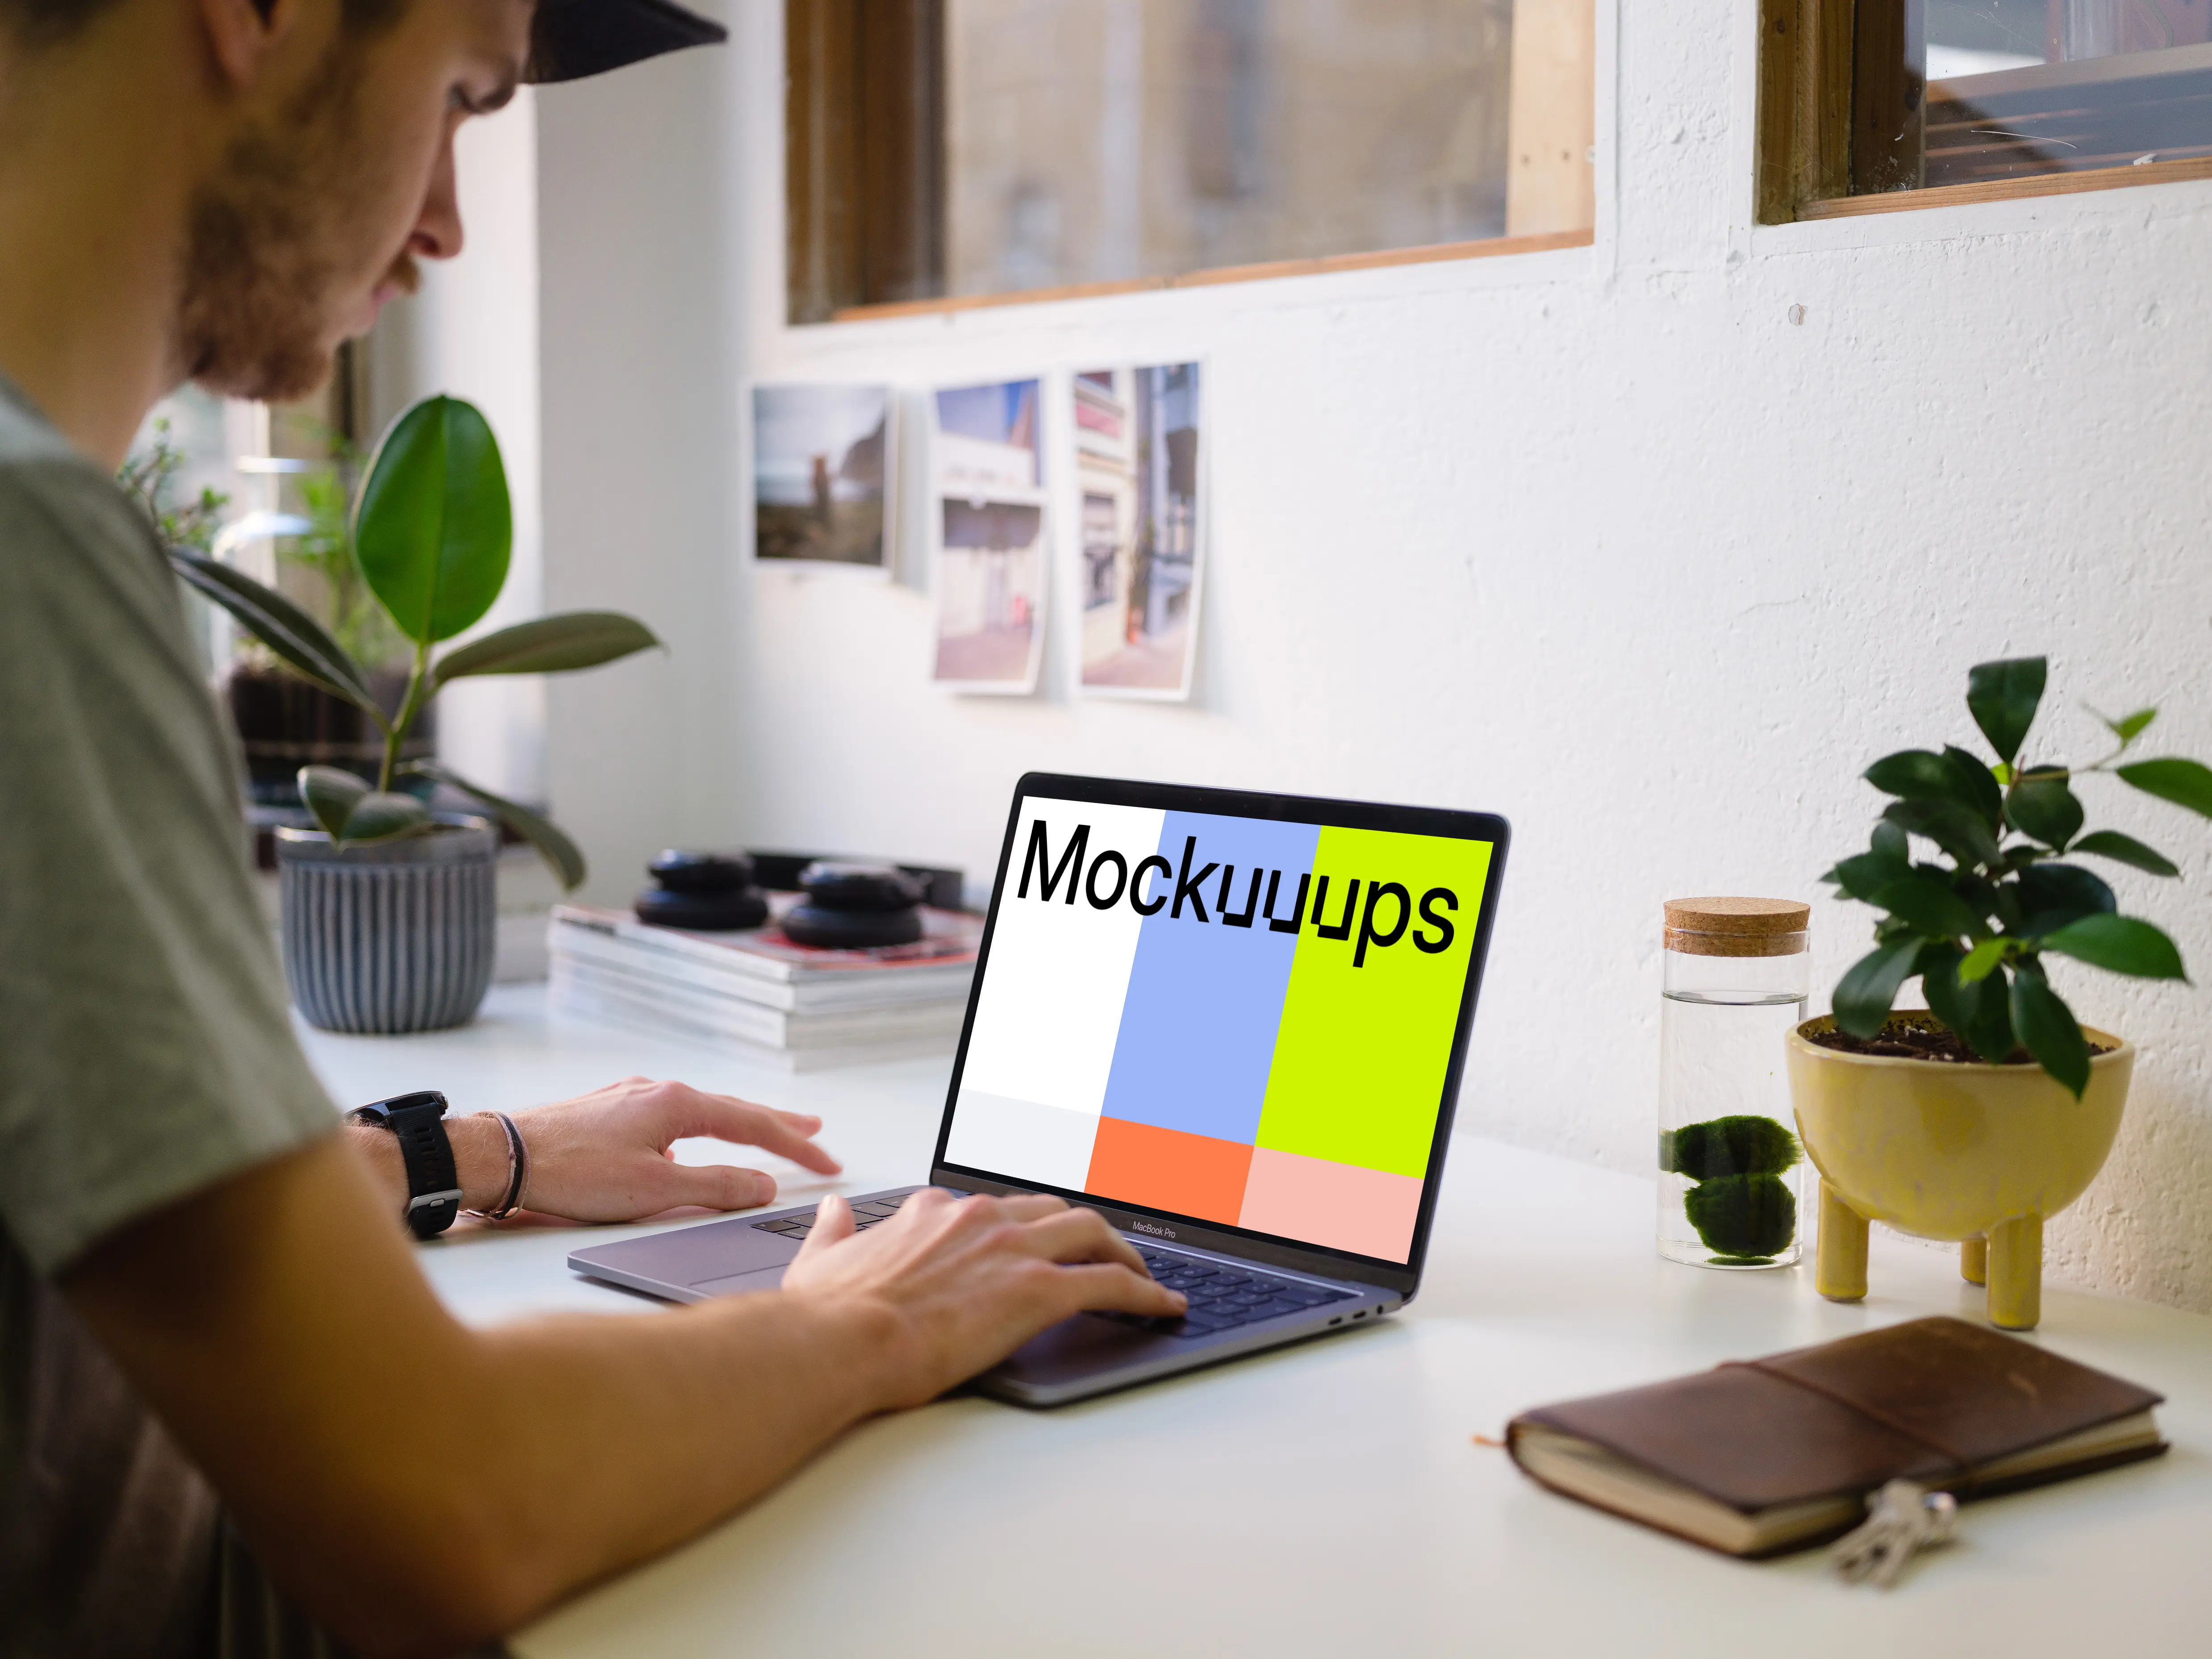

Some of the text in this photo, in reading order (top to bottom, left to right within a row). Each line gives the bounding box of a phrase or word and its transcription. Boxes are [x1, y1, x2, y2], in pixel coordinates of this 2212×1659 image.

[1017, 820, 1458, 968] Mockuuups
[1133, 1221, 1176, 1238] MacBook Pro
